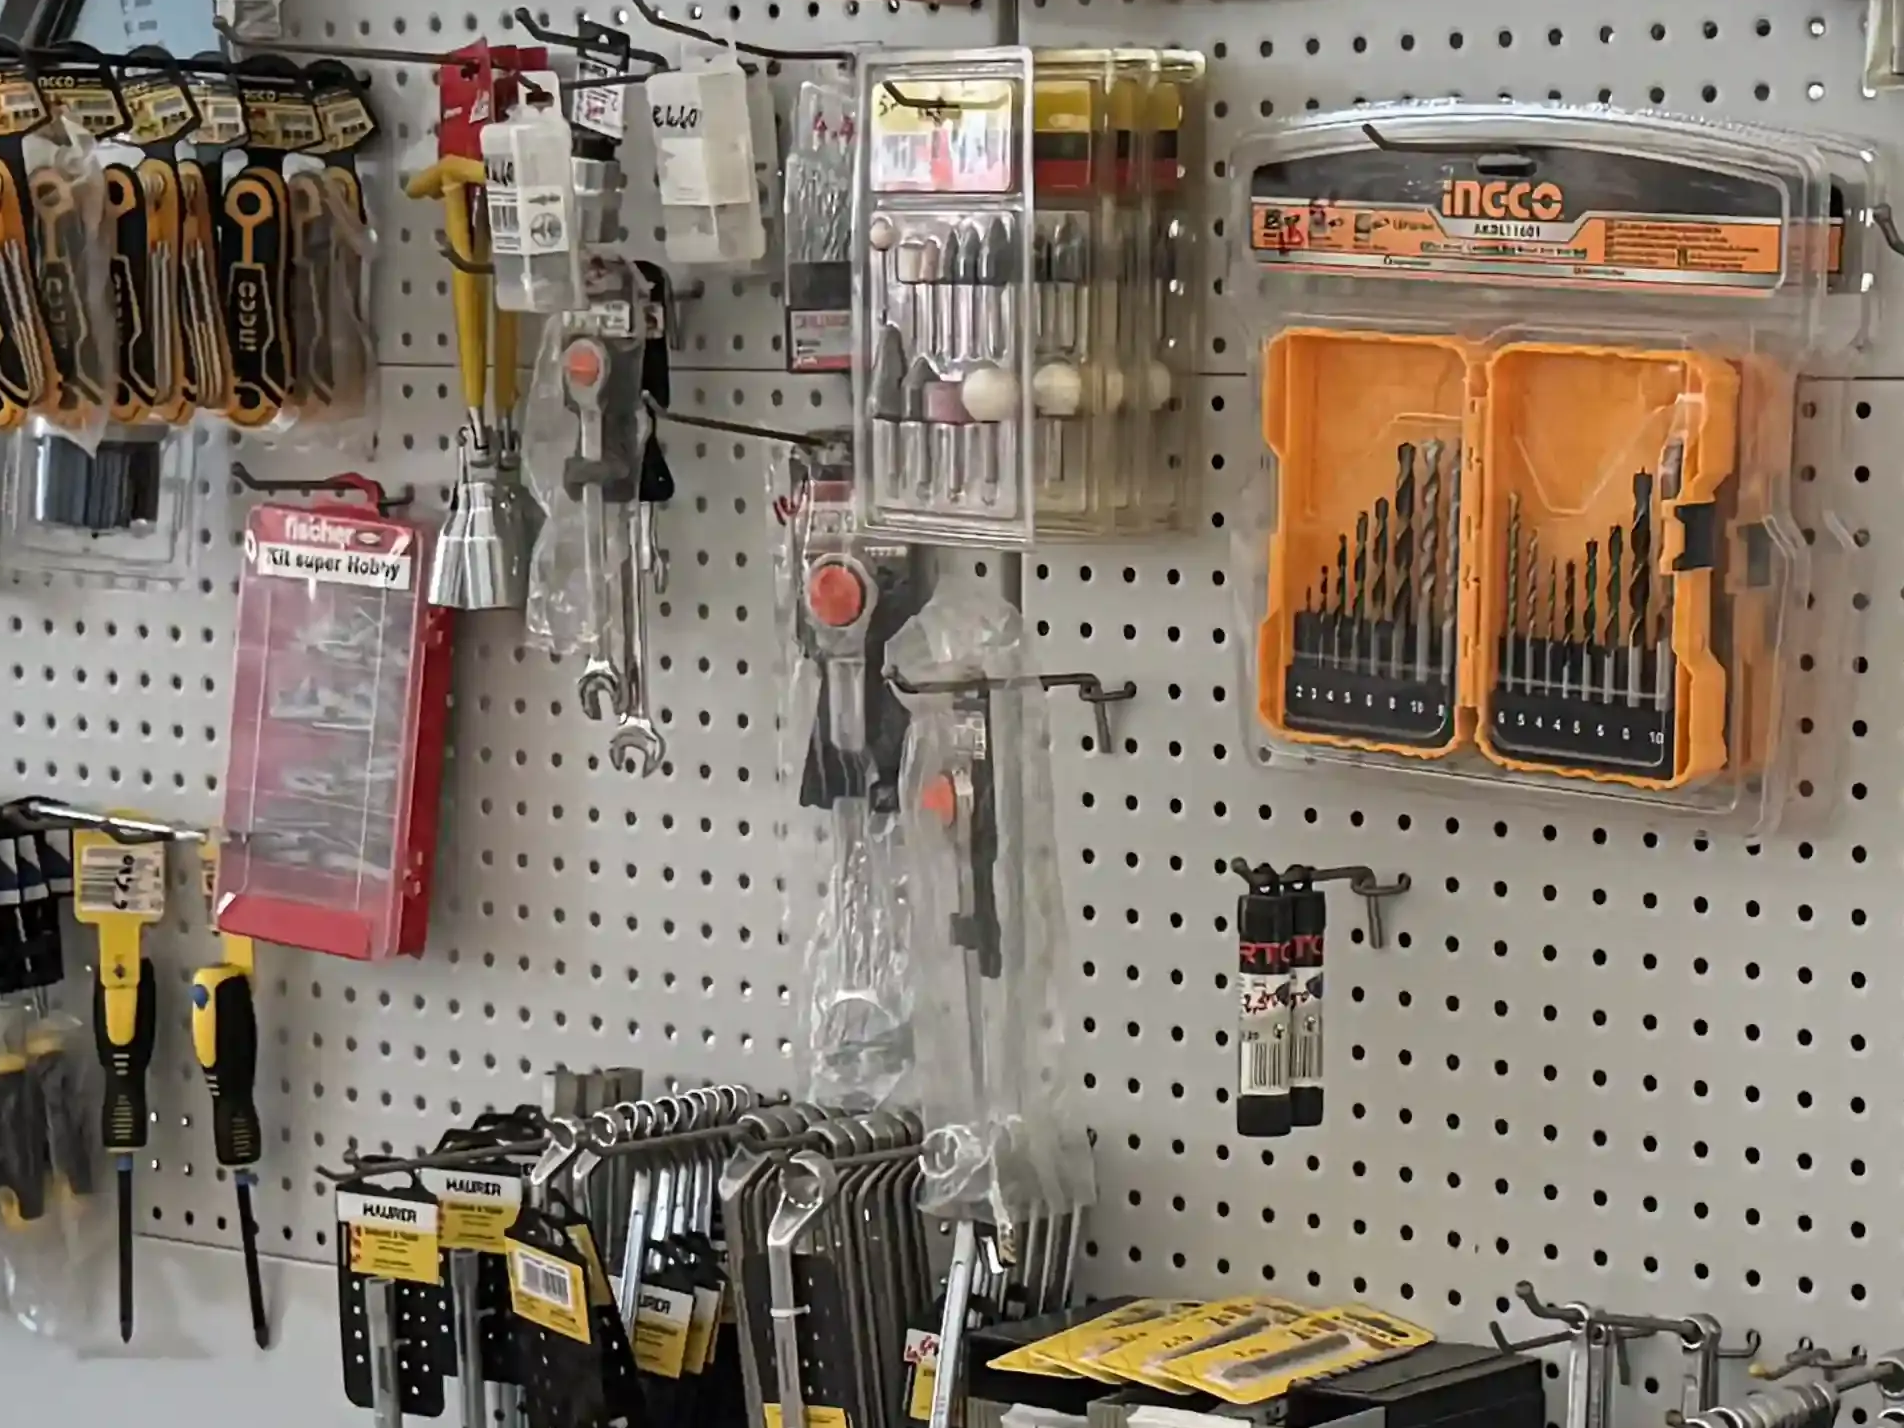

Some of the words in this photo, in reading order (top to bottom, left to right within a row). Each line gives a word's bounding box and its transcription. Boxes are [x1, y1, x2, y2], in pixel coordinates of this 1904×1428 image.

[1441, 177, 1564, 221] INGCO
[237, 279, 258, 352] INGCO
[283, 514, 358, 551] fischer
[294, 548, 340, 576] super
[445, 1176, 503, 1198] MAURER
[362, 1202, 418, 1225] MAURER
